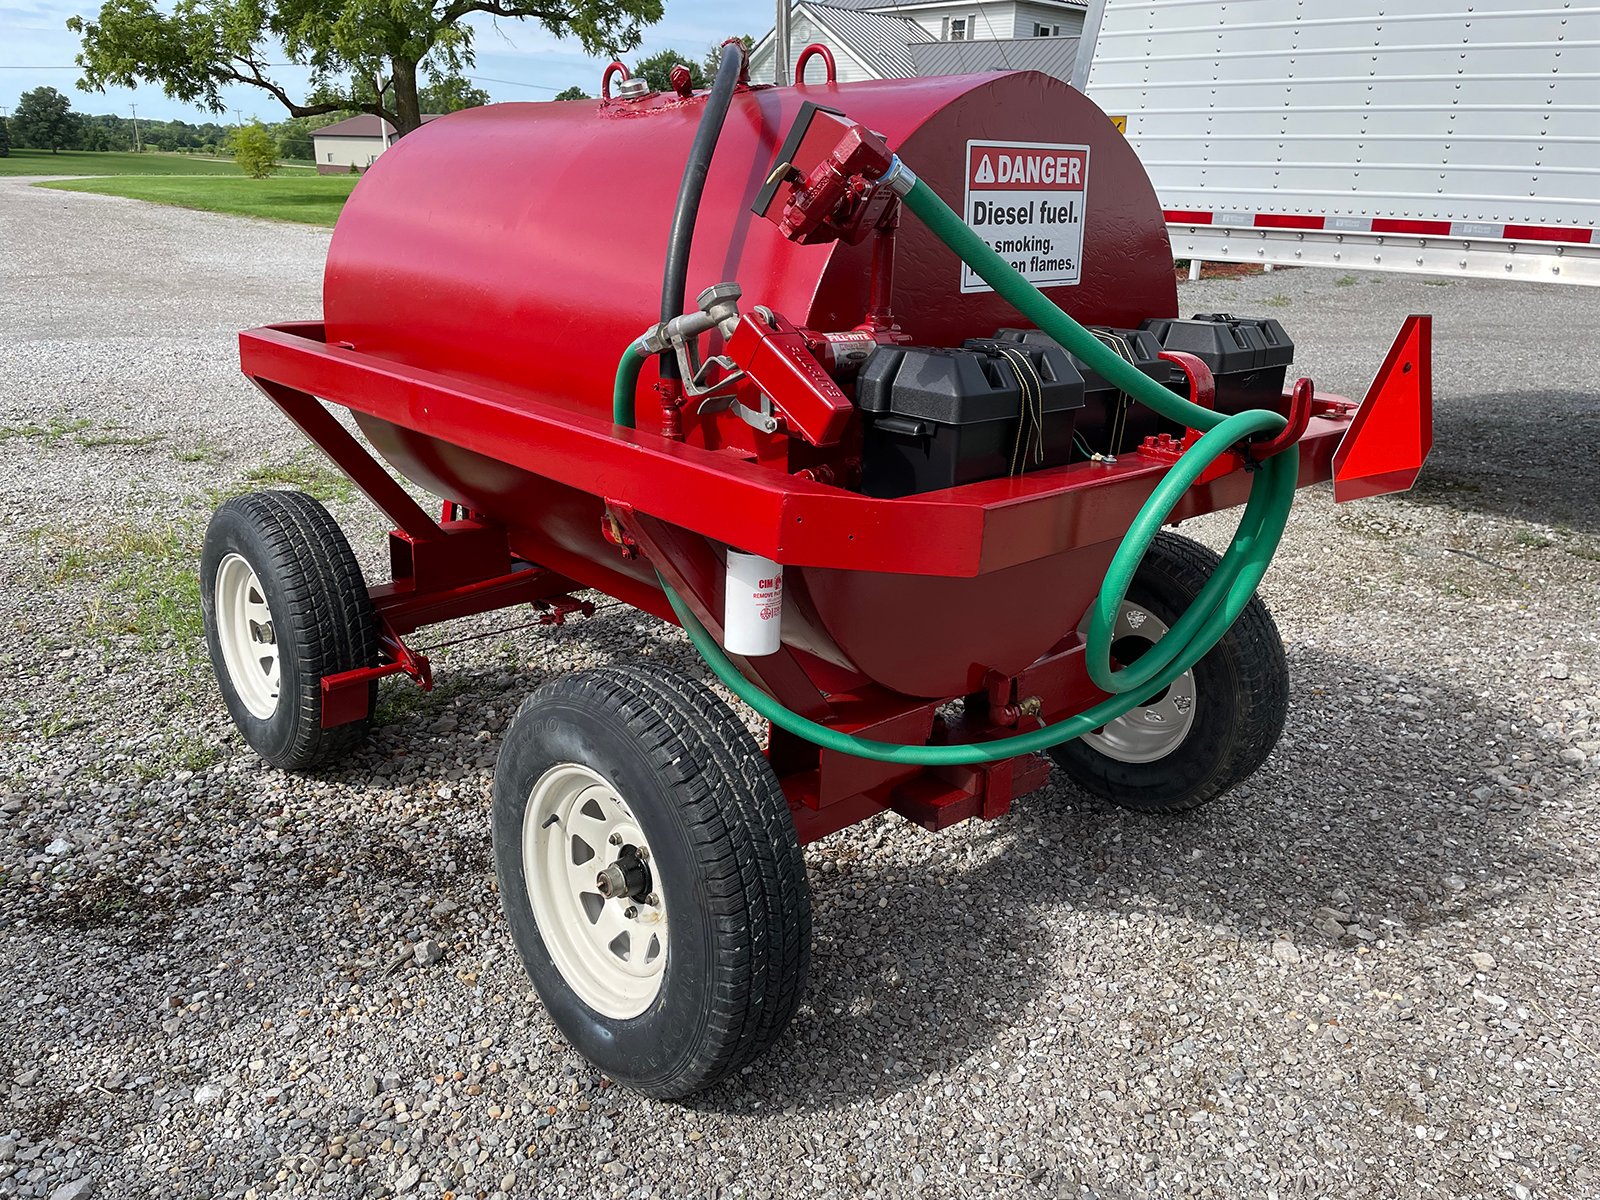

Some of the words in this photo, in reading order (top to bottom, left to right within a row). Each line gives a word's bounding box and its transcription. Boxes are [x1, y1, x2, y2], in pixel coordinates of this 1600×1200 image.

[997, 155, 1081, 184] DANGER
[973, 201, 1034, 226] Diesel
[1039, 201, 1078, 224] fuel.
[994, 235, 1054, 255] smoking.
[1030, 256, 1075, 273] flames.
[828, 334, 870, 342] FILL-RITE
[759, 579, 773, 589] CIM
